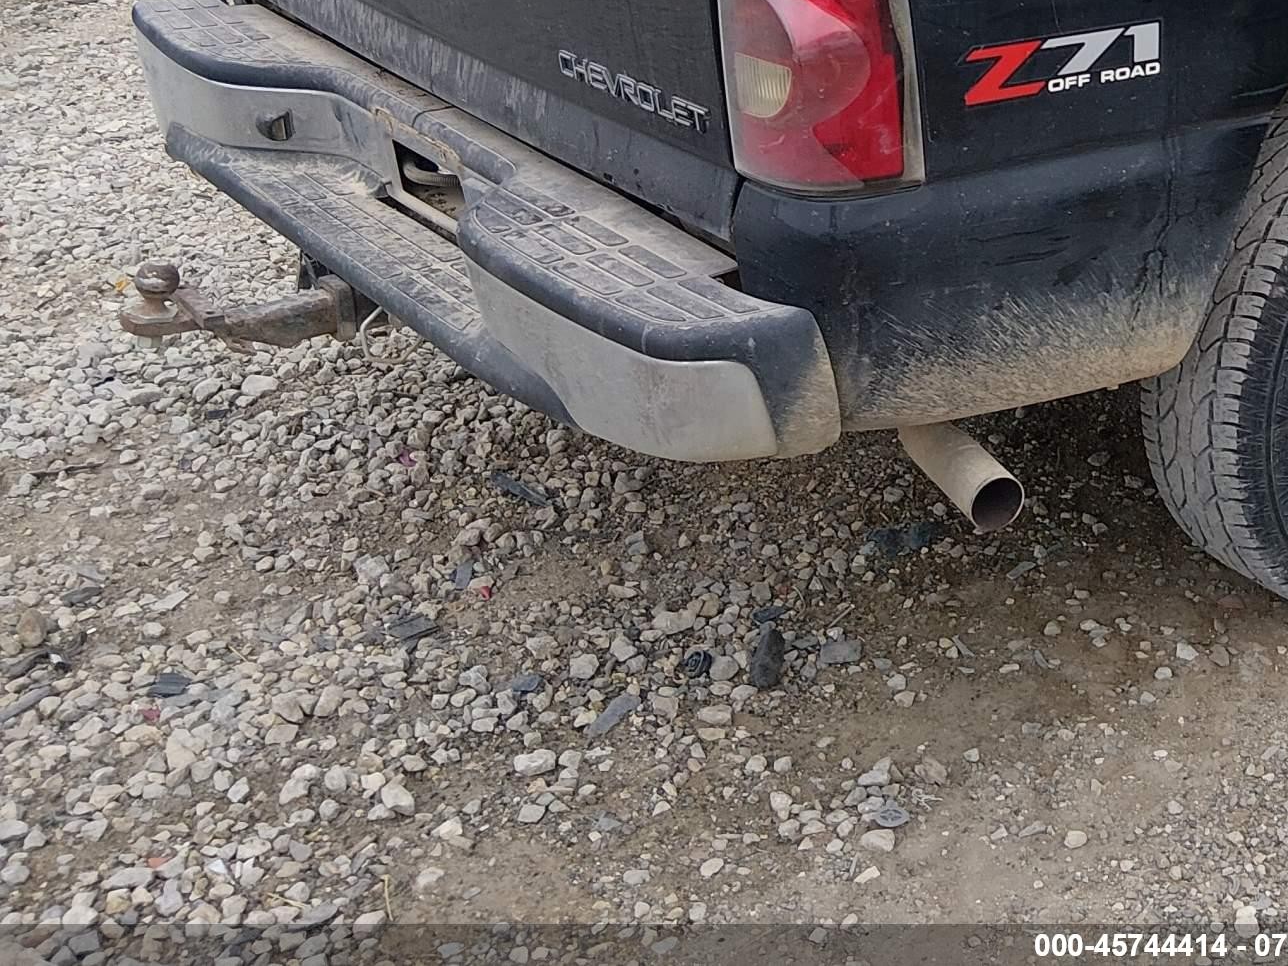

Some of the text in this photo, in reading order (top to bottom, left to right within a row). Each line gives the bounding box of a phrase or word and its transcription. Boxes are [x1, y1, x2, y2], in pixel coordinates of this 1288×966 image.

[558, 49, 709, 132] CHEVROLET
[964, 21, 1160, 106] Z71
[1047, 62, 1161, 93] OFF ROAD
